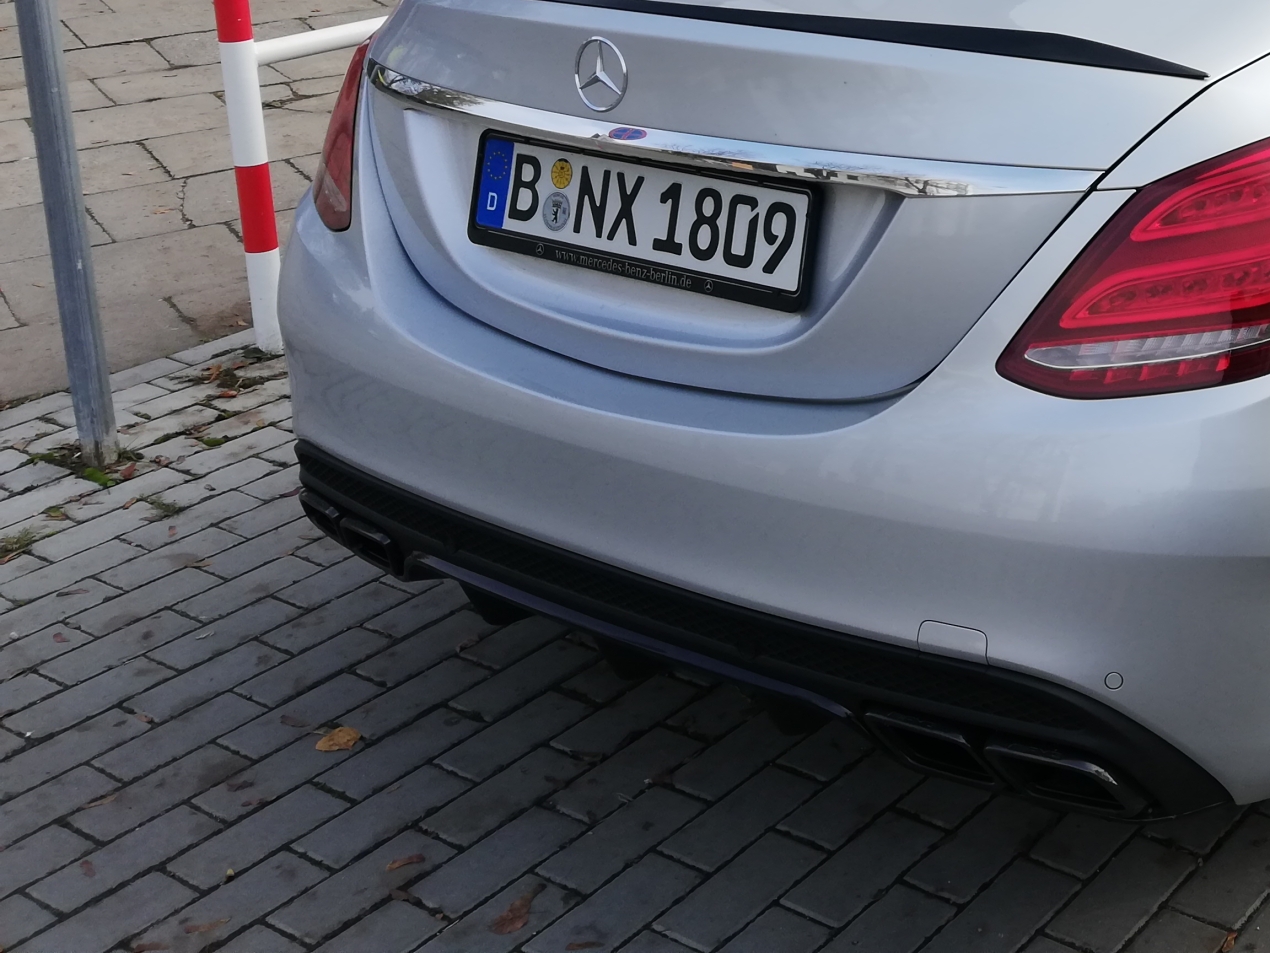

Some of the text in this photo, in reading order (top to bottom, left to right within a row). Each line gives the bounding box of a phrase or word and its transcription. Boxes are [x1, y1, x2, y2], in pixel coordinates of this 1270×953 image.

[487, 192, 498, 211] D
[508, 153, 542, 222] B
[573, 165, 645, 246] NX
[652, 182, 797, 275] 1809
[555, 248, 692, 289] www.mercedes-benz-berlin.de
